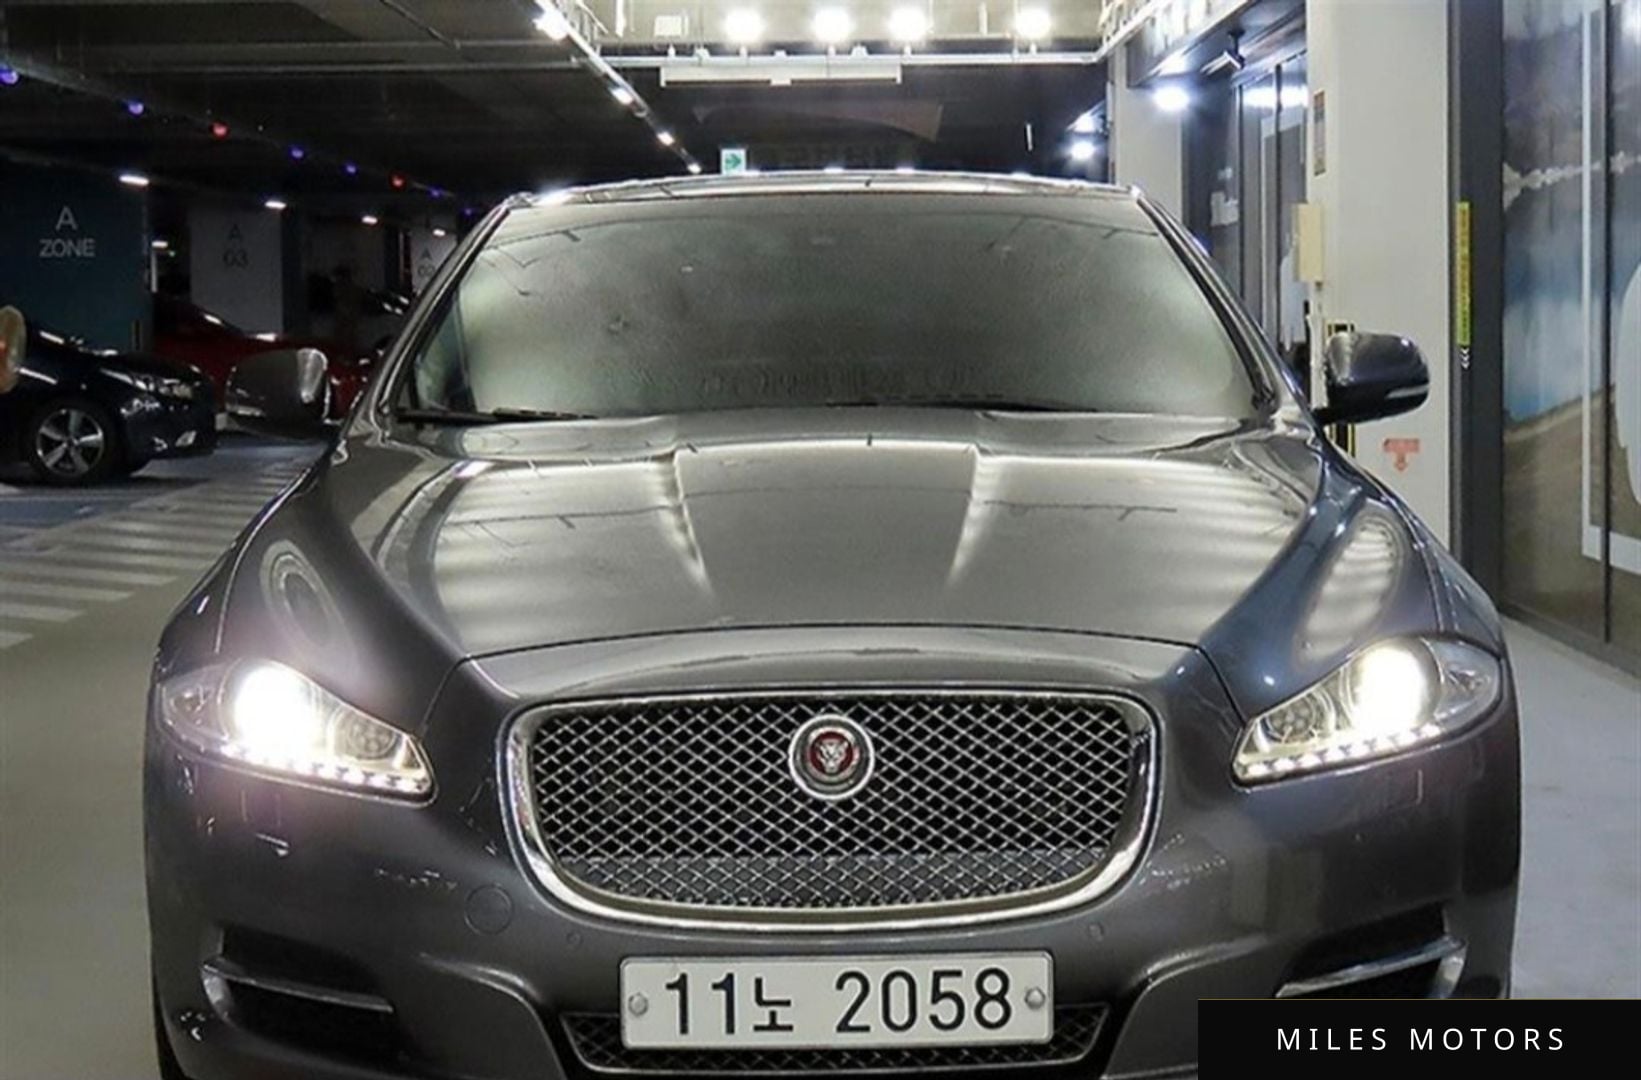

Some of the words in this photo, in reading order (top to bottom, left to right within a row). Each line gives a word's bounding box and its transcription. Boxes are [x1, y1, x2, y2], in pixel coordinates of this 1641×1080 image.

[56, 206, 77, 230] A
[226, 224, 243, 243] A
[40, 239, 95, 257] ZONE
[222, 248, 248, 269] 03
[665, 972, 794, 1035] 11노
[835, 967, 1012, 1032] 2058
